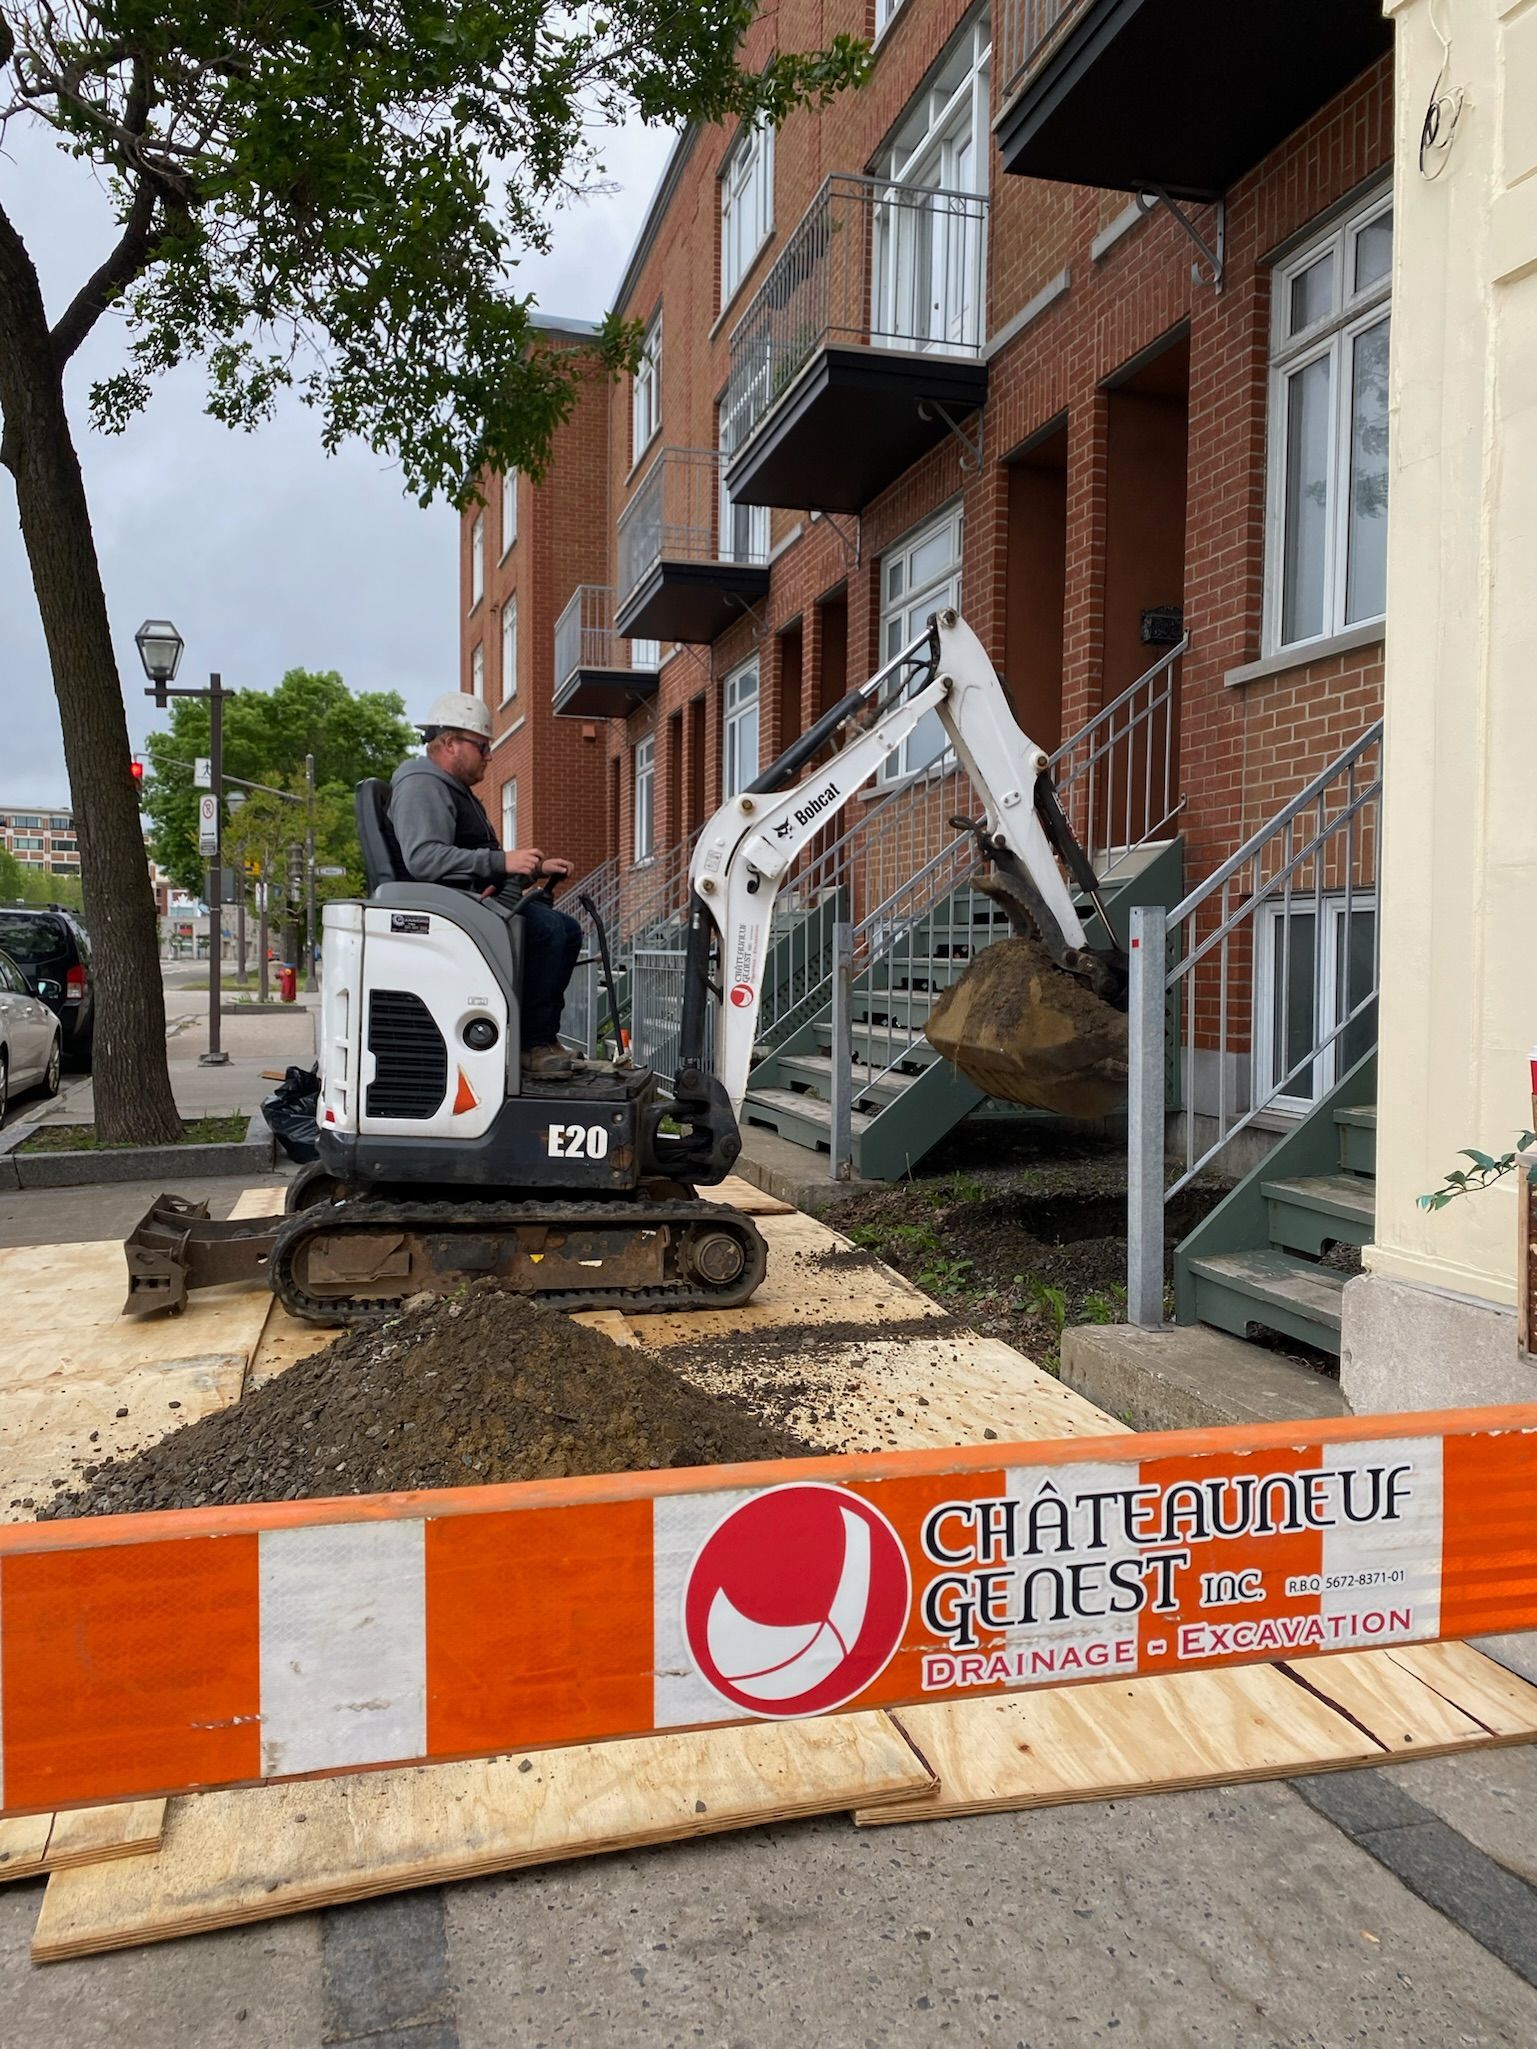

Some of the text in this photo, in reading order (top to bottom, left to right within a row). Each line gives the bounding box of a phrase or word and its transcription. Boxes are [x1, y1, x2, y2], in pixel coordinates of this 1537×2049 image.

[794, 782, 841, 826] Bobcat
[548, 1124, 608, 1159] E20
[925, 1465, 1411, 1562] CHÂTEAUNEUF
[925, 1553, 1187, 1646] GENEST
[1325, 1570, 1405, 1590] 5672-8371-01
[926, 1639, 1135, 1687] DRAINAGE
[1181, 1608, 1412, 1656] EXCAVATION
